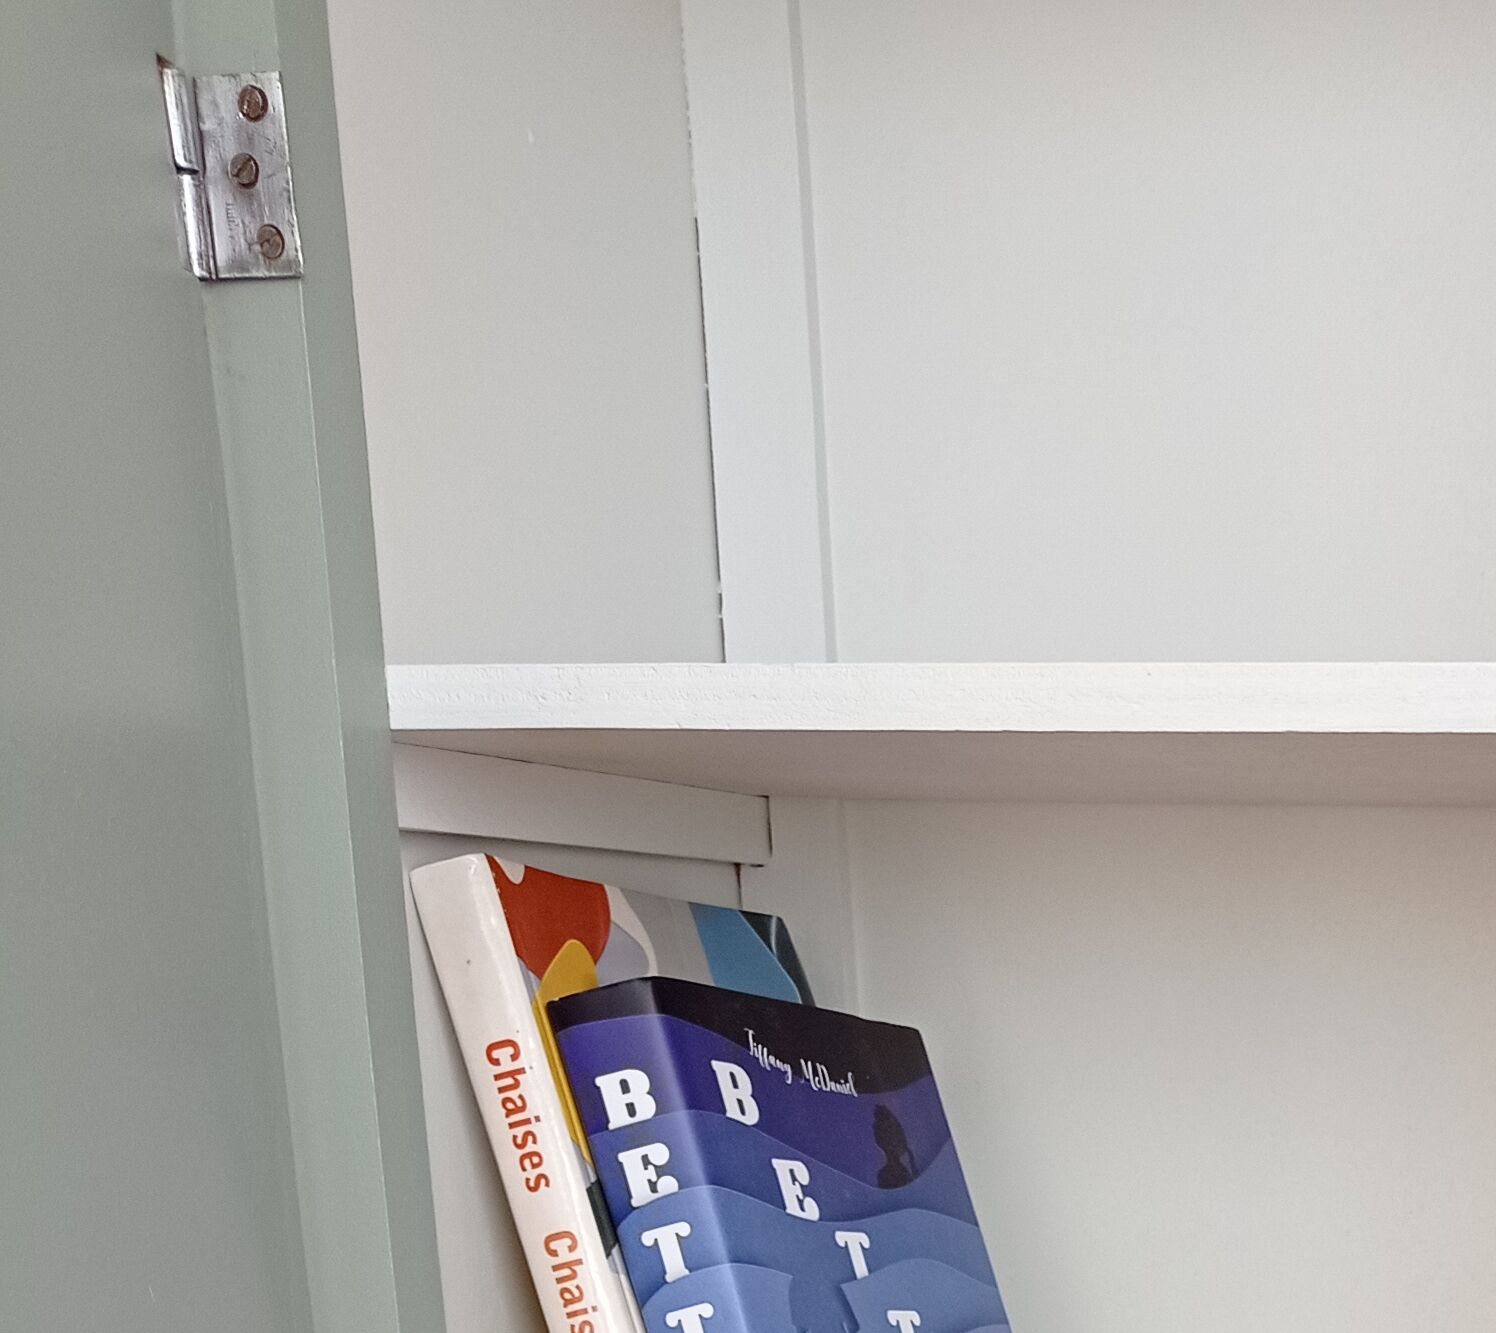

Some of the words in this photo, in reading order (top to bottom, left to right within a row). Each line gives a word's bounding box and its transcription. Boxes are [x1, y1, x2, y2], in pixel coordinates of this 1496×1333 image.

[485, 1038, 550, 1193] Chaises
[744, 1028, 792, 1084] Tiffany
[800, 1058, 857, 1097] McDaniel
